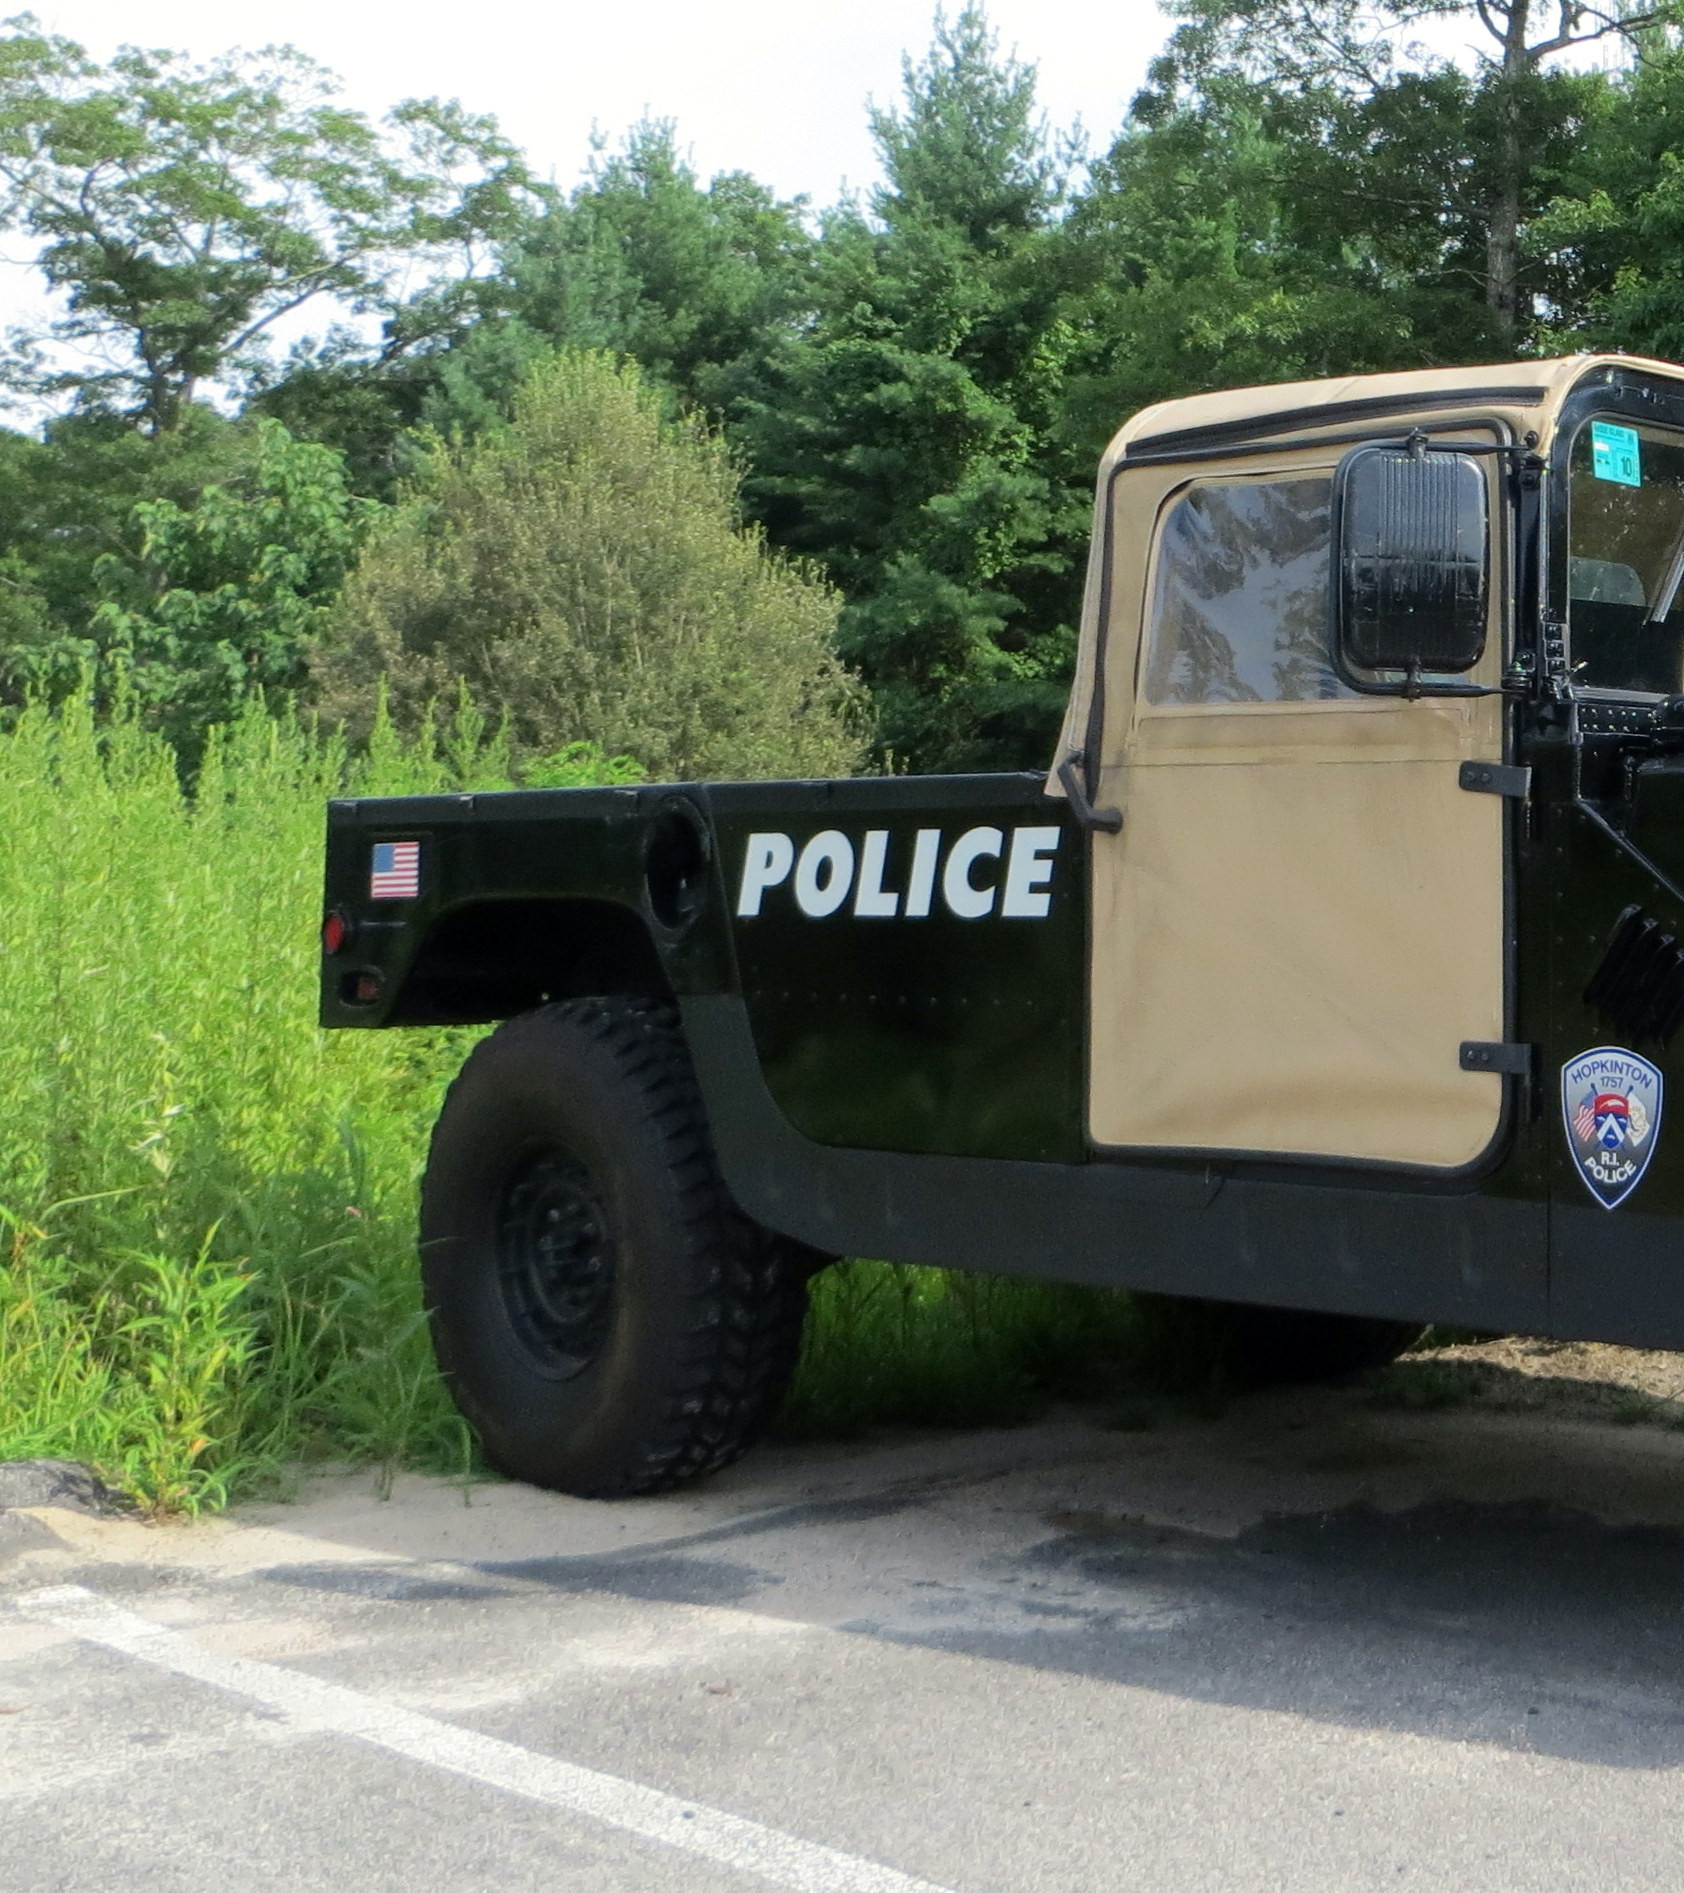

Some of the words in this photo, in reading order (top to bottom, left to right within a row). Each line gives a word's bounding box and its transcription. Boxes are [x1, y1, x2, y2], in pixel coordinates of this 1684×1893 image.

[737, 826, 1061, 918] POLICE
[1571, 1059, 1652, 1089] HOPKINTON
[1601, 1076, 1624, 1089] 1757
[1584, 1156, 1637, 1184] POLICE
[1601, 1151, 1620, 1166] R.I.
